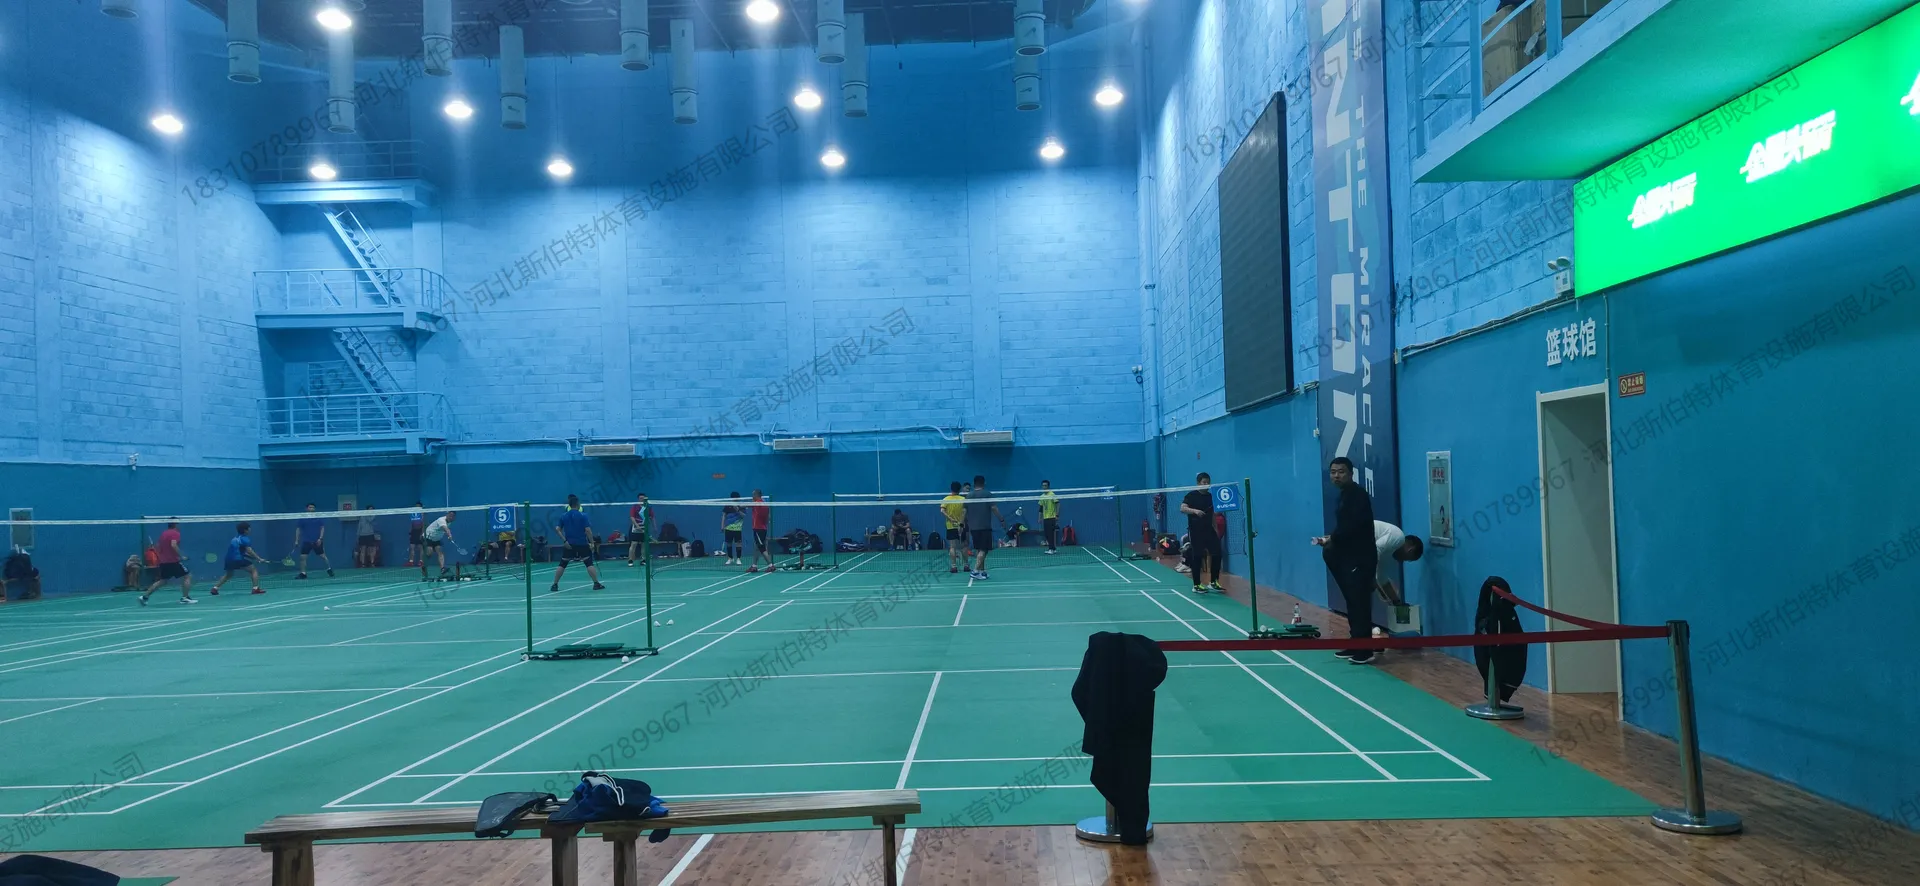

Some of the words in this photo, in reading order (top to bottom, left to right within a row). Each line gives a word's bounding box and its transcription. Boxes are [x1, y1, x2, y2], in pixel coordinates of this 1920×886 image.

[1356, 95, 1367, 209] THE
[1546, 317, 1596, 366] 篮球馆
[1360, 247, 1374, 497] MIRACLE
[498, 509, 507, 521] 5
[1220, 488, 1230, 501] 6
